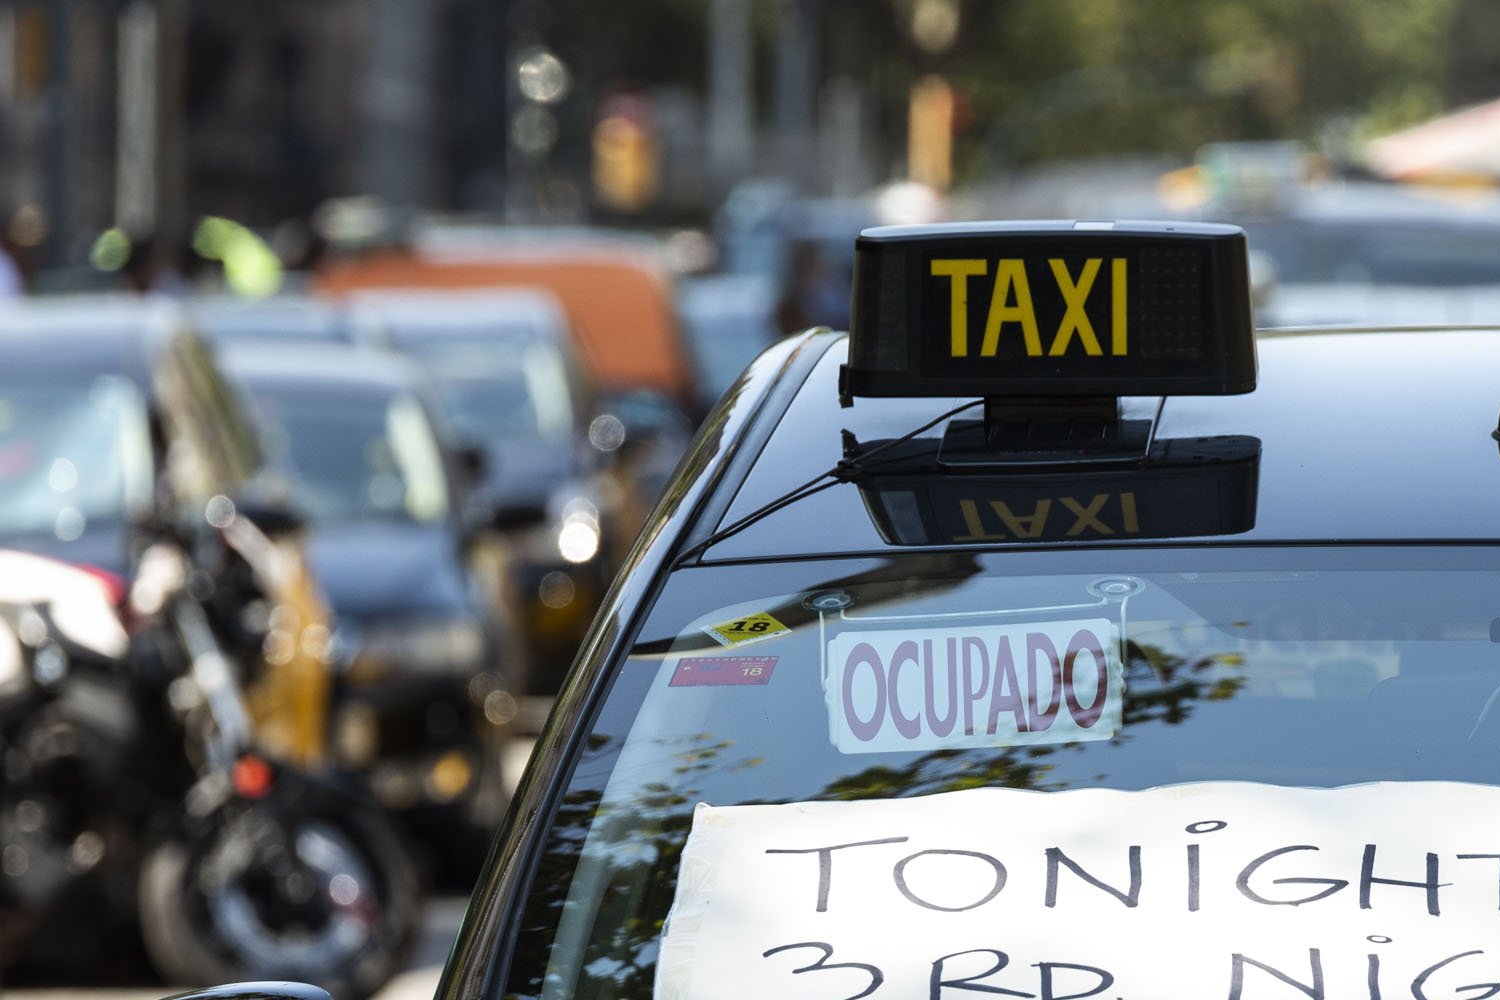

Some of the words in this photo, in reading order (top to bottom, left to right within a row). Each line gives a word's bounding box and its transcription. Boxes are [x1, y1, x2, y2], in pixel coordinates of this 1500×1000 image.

[930, 258, 1128, 357] TAXI
[728, 621, 771, 632] 18
[741, 667, 763, 677] 18
[842, 628, 1108, 742] OCUPADO
